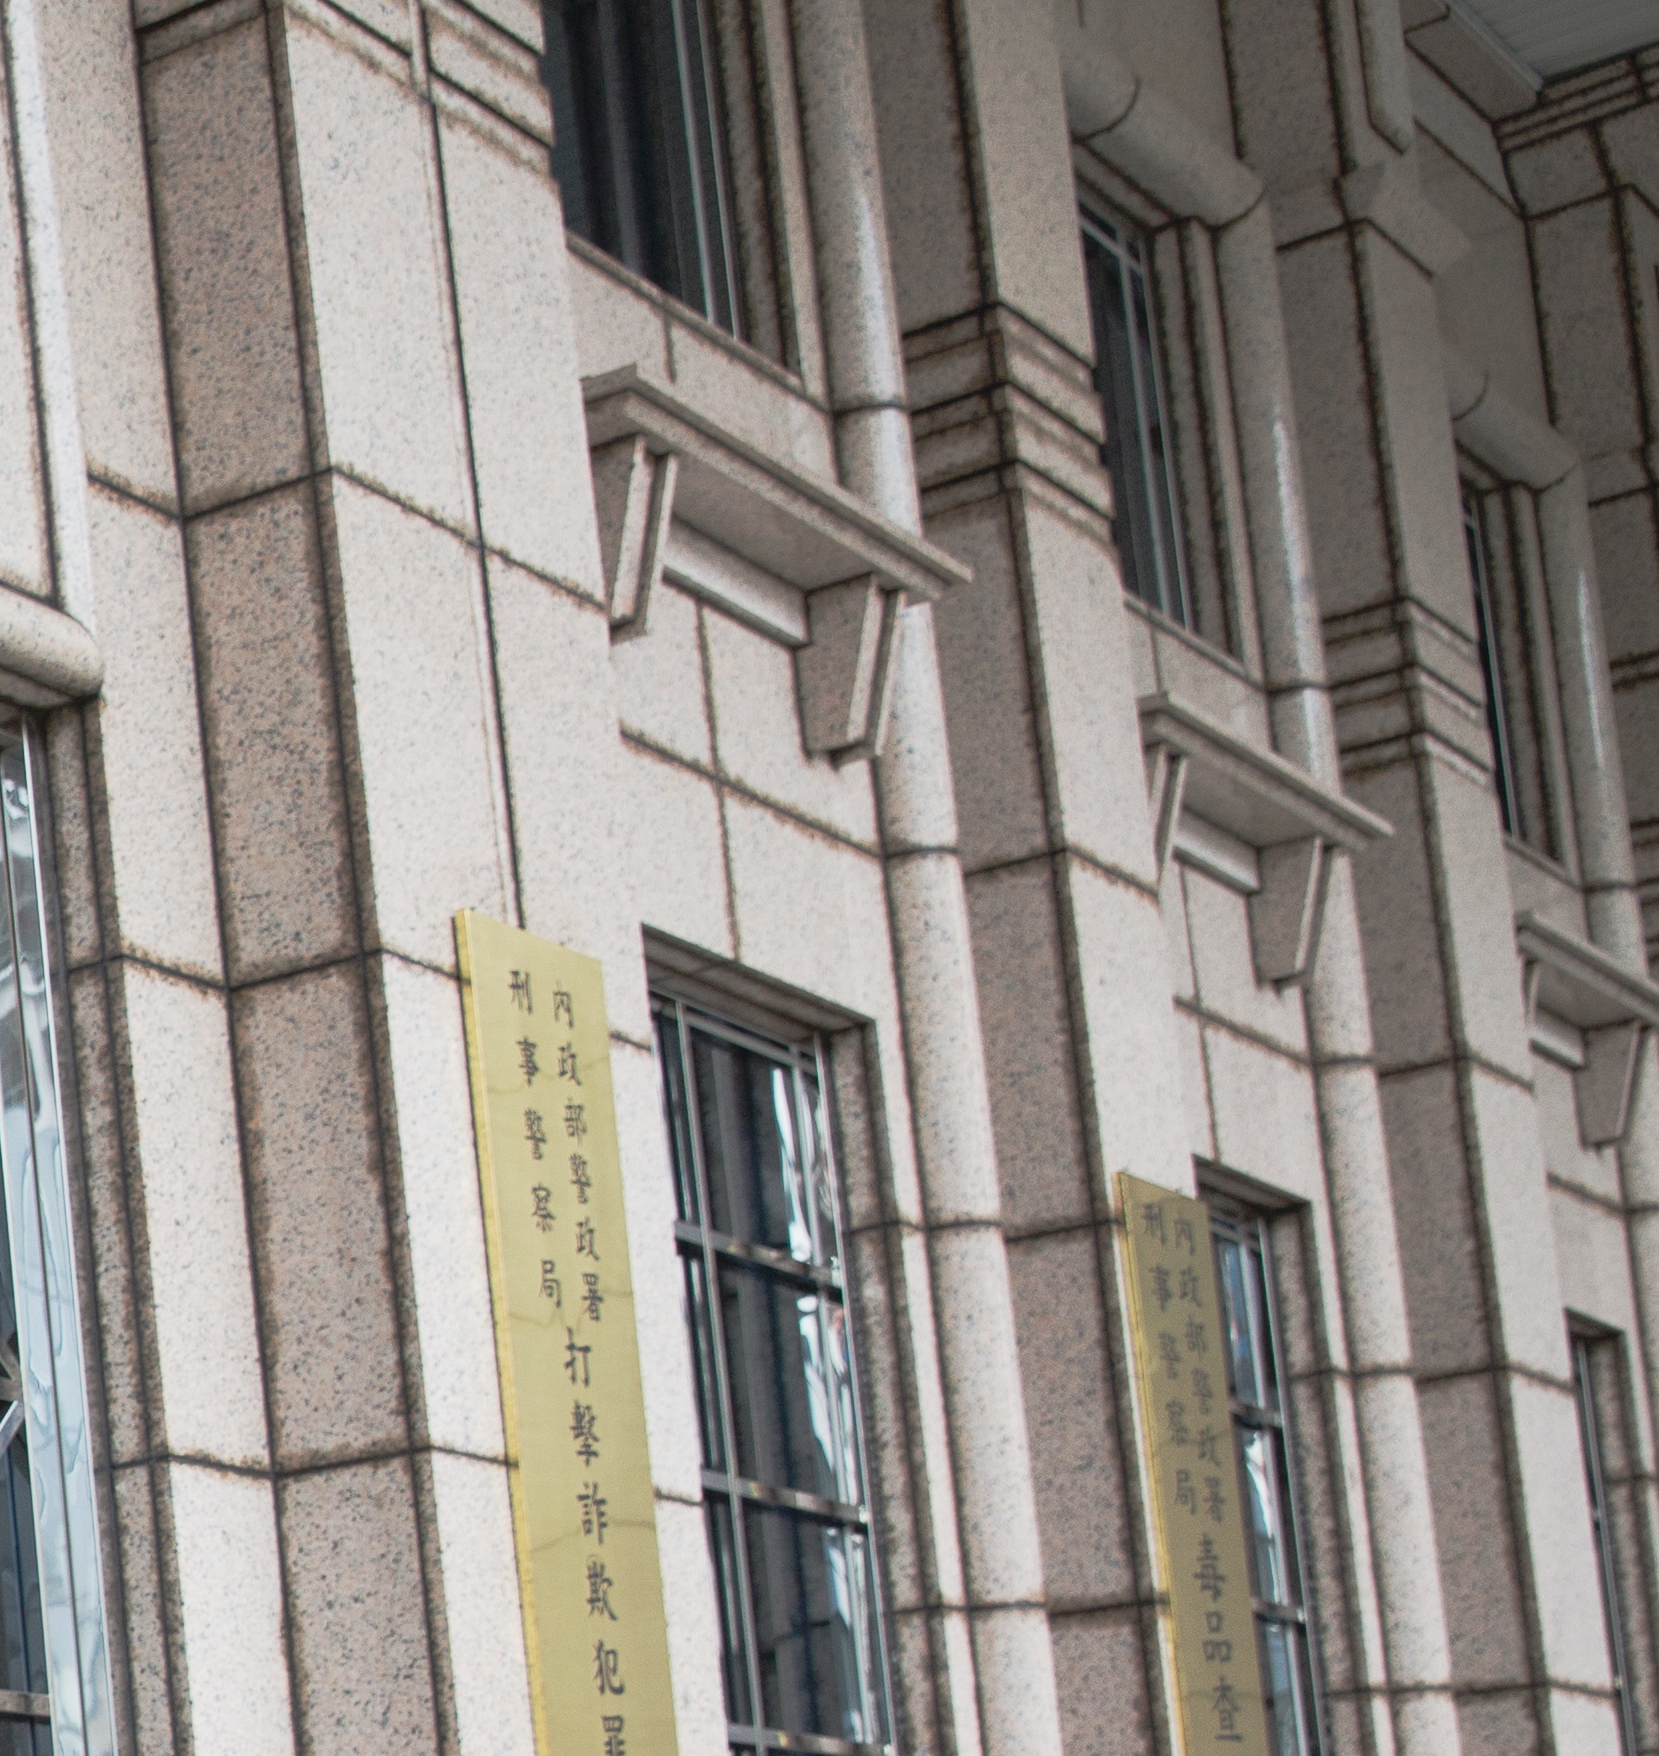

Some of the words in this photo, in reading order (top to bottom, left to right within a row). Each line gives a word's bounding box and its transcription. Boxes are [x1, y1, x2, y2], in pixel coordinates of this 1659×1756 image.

[508, 969, 563, 1309] 刑事警察局
